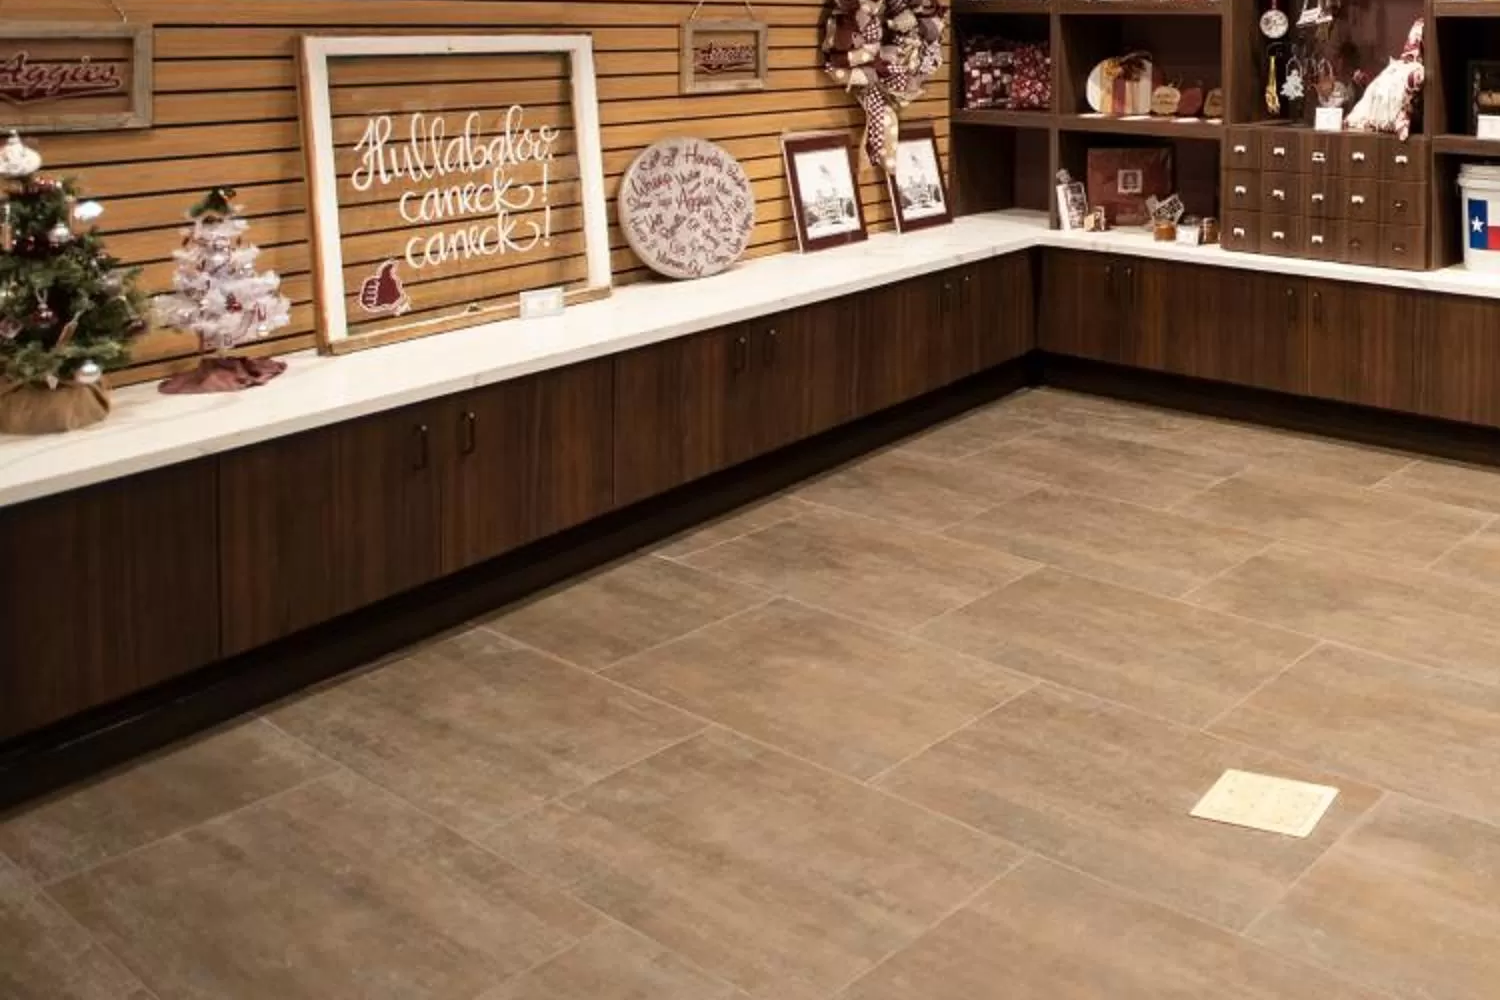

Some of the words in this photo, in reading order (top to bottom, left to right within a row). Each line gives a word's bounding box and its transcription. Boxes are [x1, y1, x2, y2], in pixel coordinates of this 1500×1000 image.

[0, 50, 123, 102] Aggies
[400, 164, 549, 222] caneck!
[406, 205, 551, 268] caneck!
